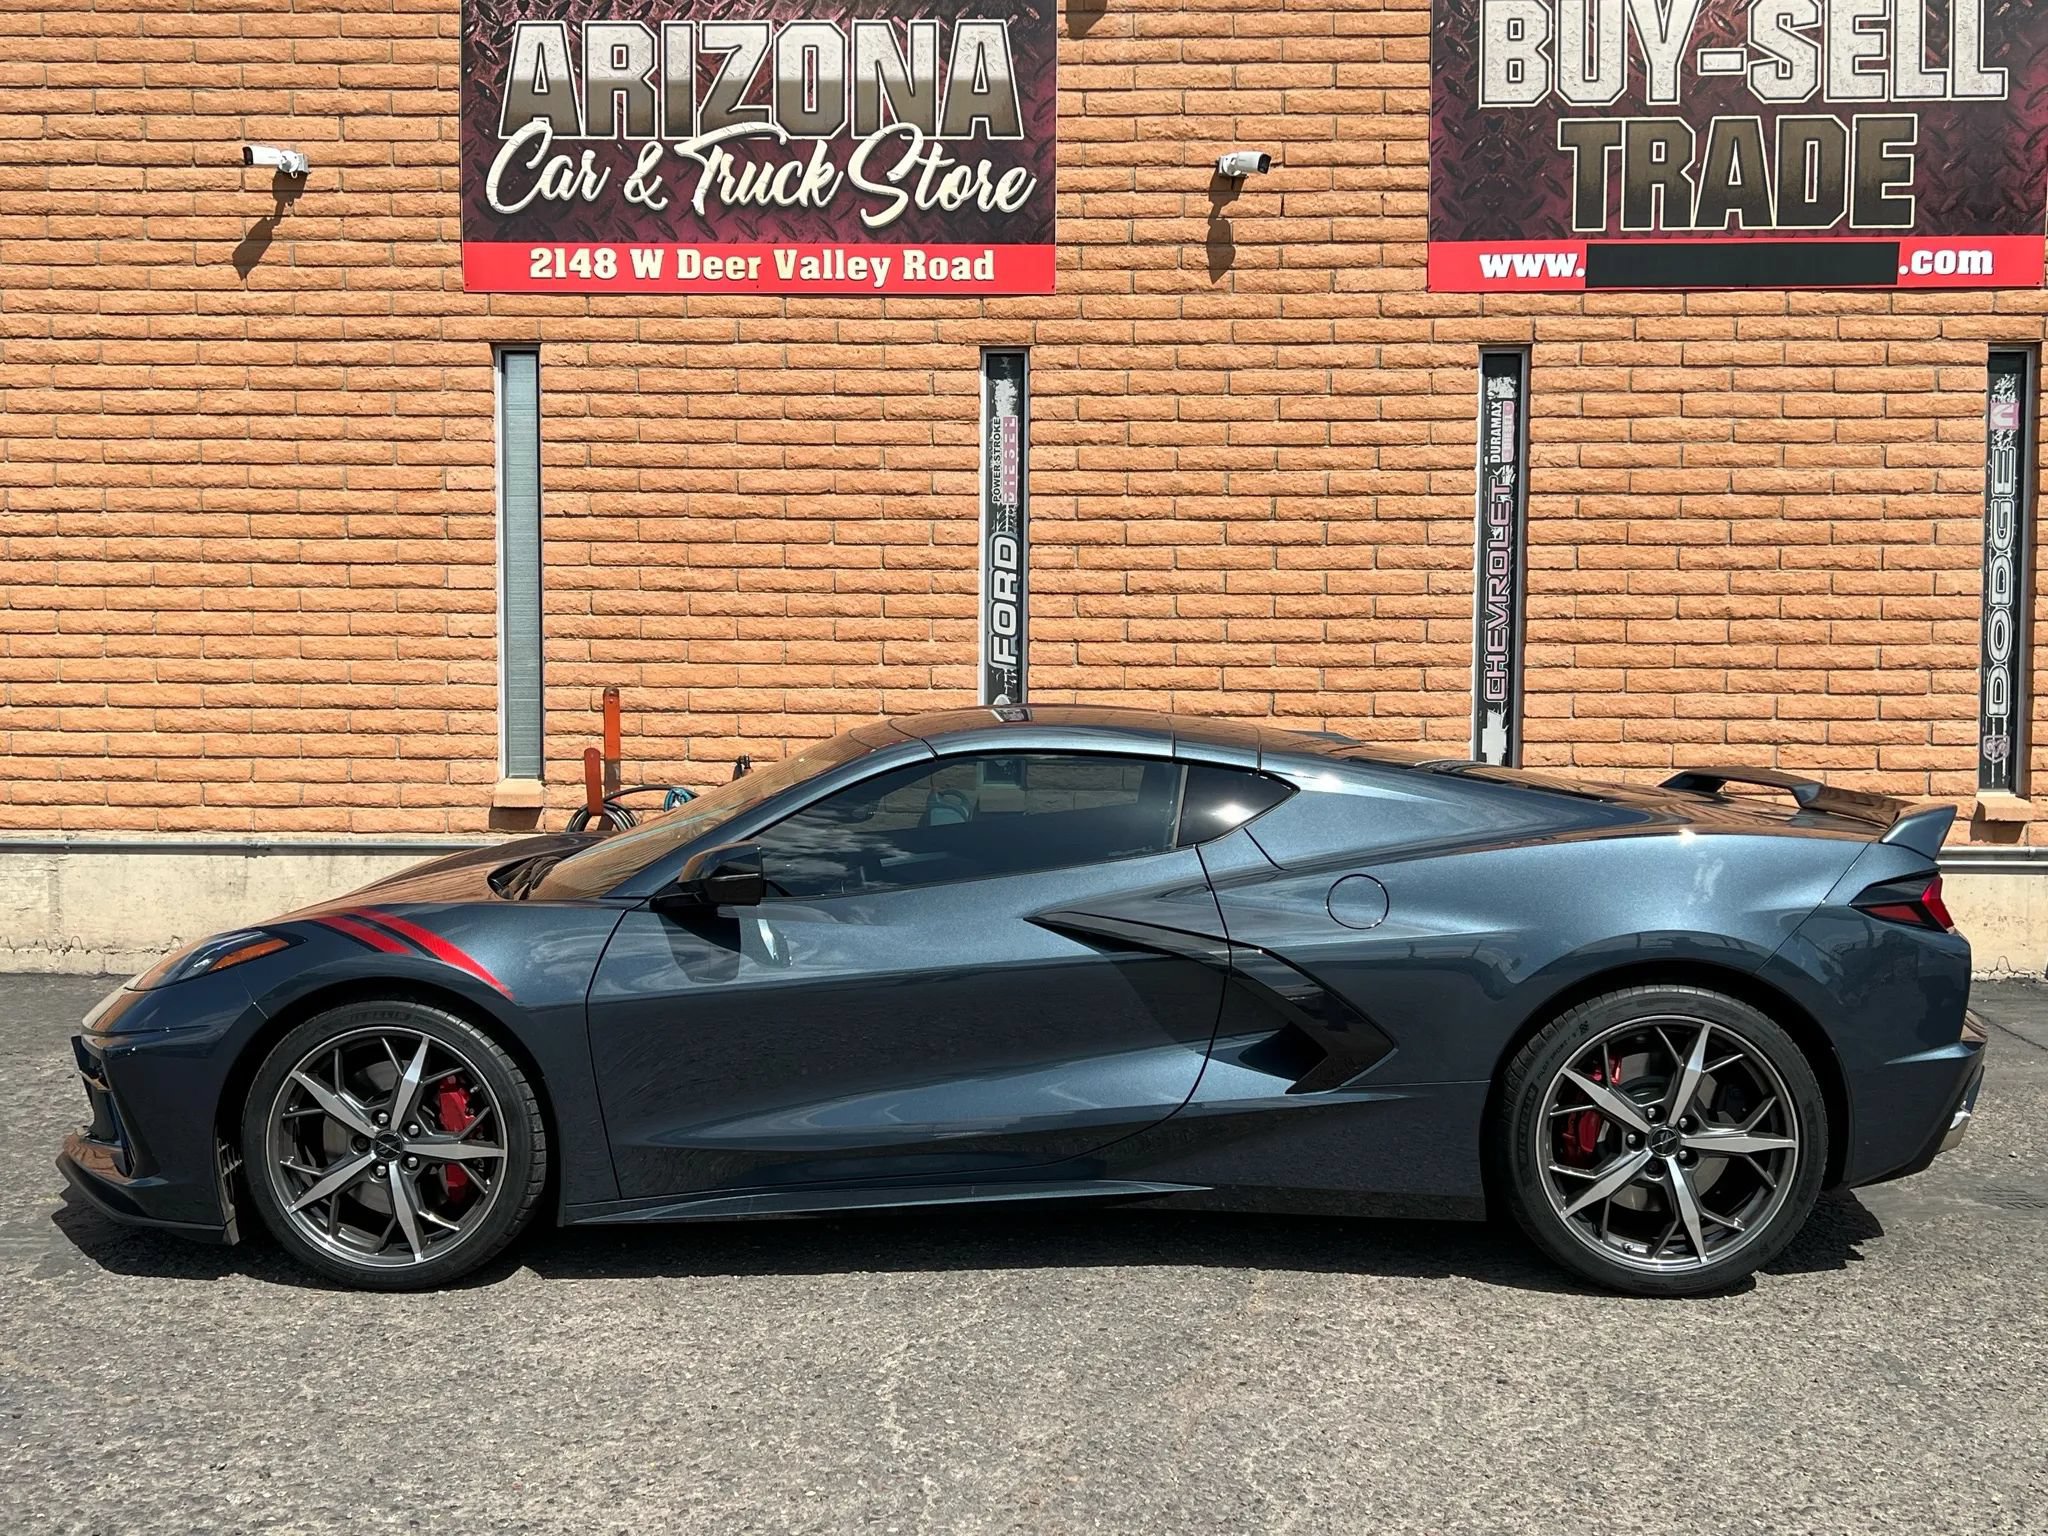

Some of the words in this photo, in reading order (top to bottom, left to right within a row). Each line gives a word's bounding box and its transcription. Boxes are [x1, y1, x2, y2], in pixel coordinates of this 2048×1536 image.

[498, 19, 1024, 140] ARIZONA
[1479, 0, 2008, 107] BUY-SELL
[485, 121, 611, 213] Car
[623, 140, 667, 212] &
[674, 121, 846, 216] Truck
[847, 122, 1036, 228] Store
[1559, 114, 1918, 231] TRADE
[529, 248, 617, 280] 2148
[628, 248, 664, 279] W
[677, 248, 761, 280] Deer
[773, 248, 891, 288] Valley
[903, 248, 995, 281] Road
[1479, 251, 1585, 279] www.
[1899, 248, 1994, 275] .com
[993, 417, 1001, 461] STROKE
[993, 465, 1001, 502] POWER
[1003, 417, 1015, 503] DIESEL
[1490, 401, 1502, 463] DURAMAX
[991, 534, 1018, 666] FORD
[1484, 476, 1512, 701] CHEVROLET
[1987, 448, 2015, 717] DODGE
